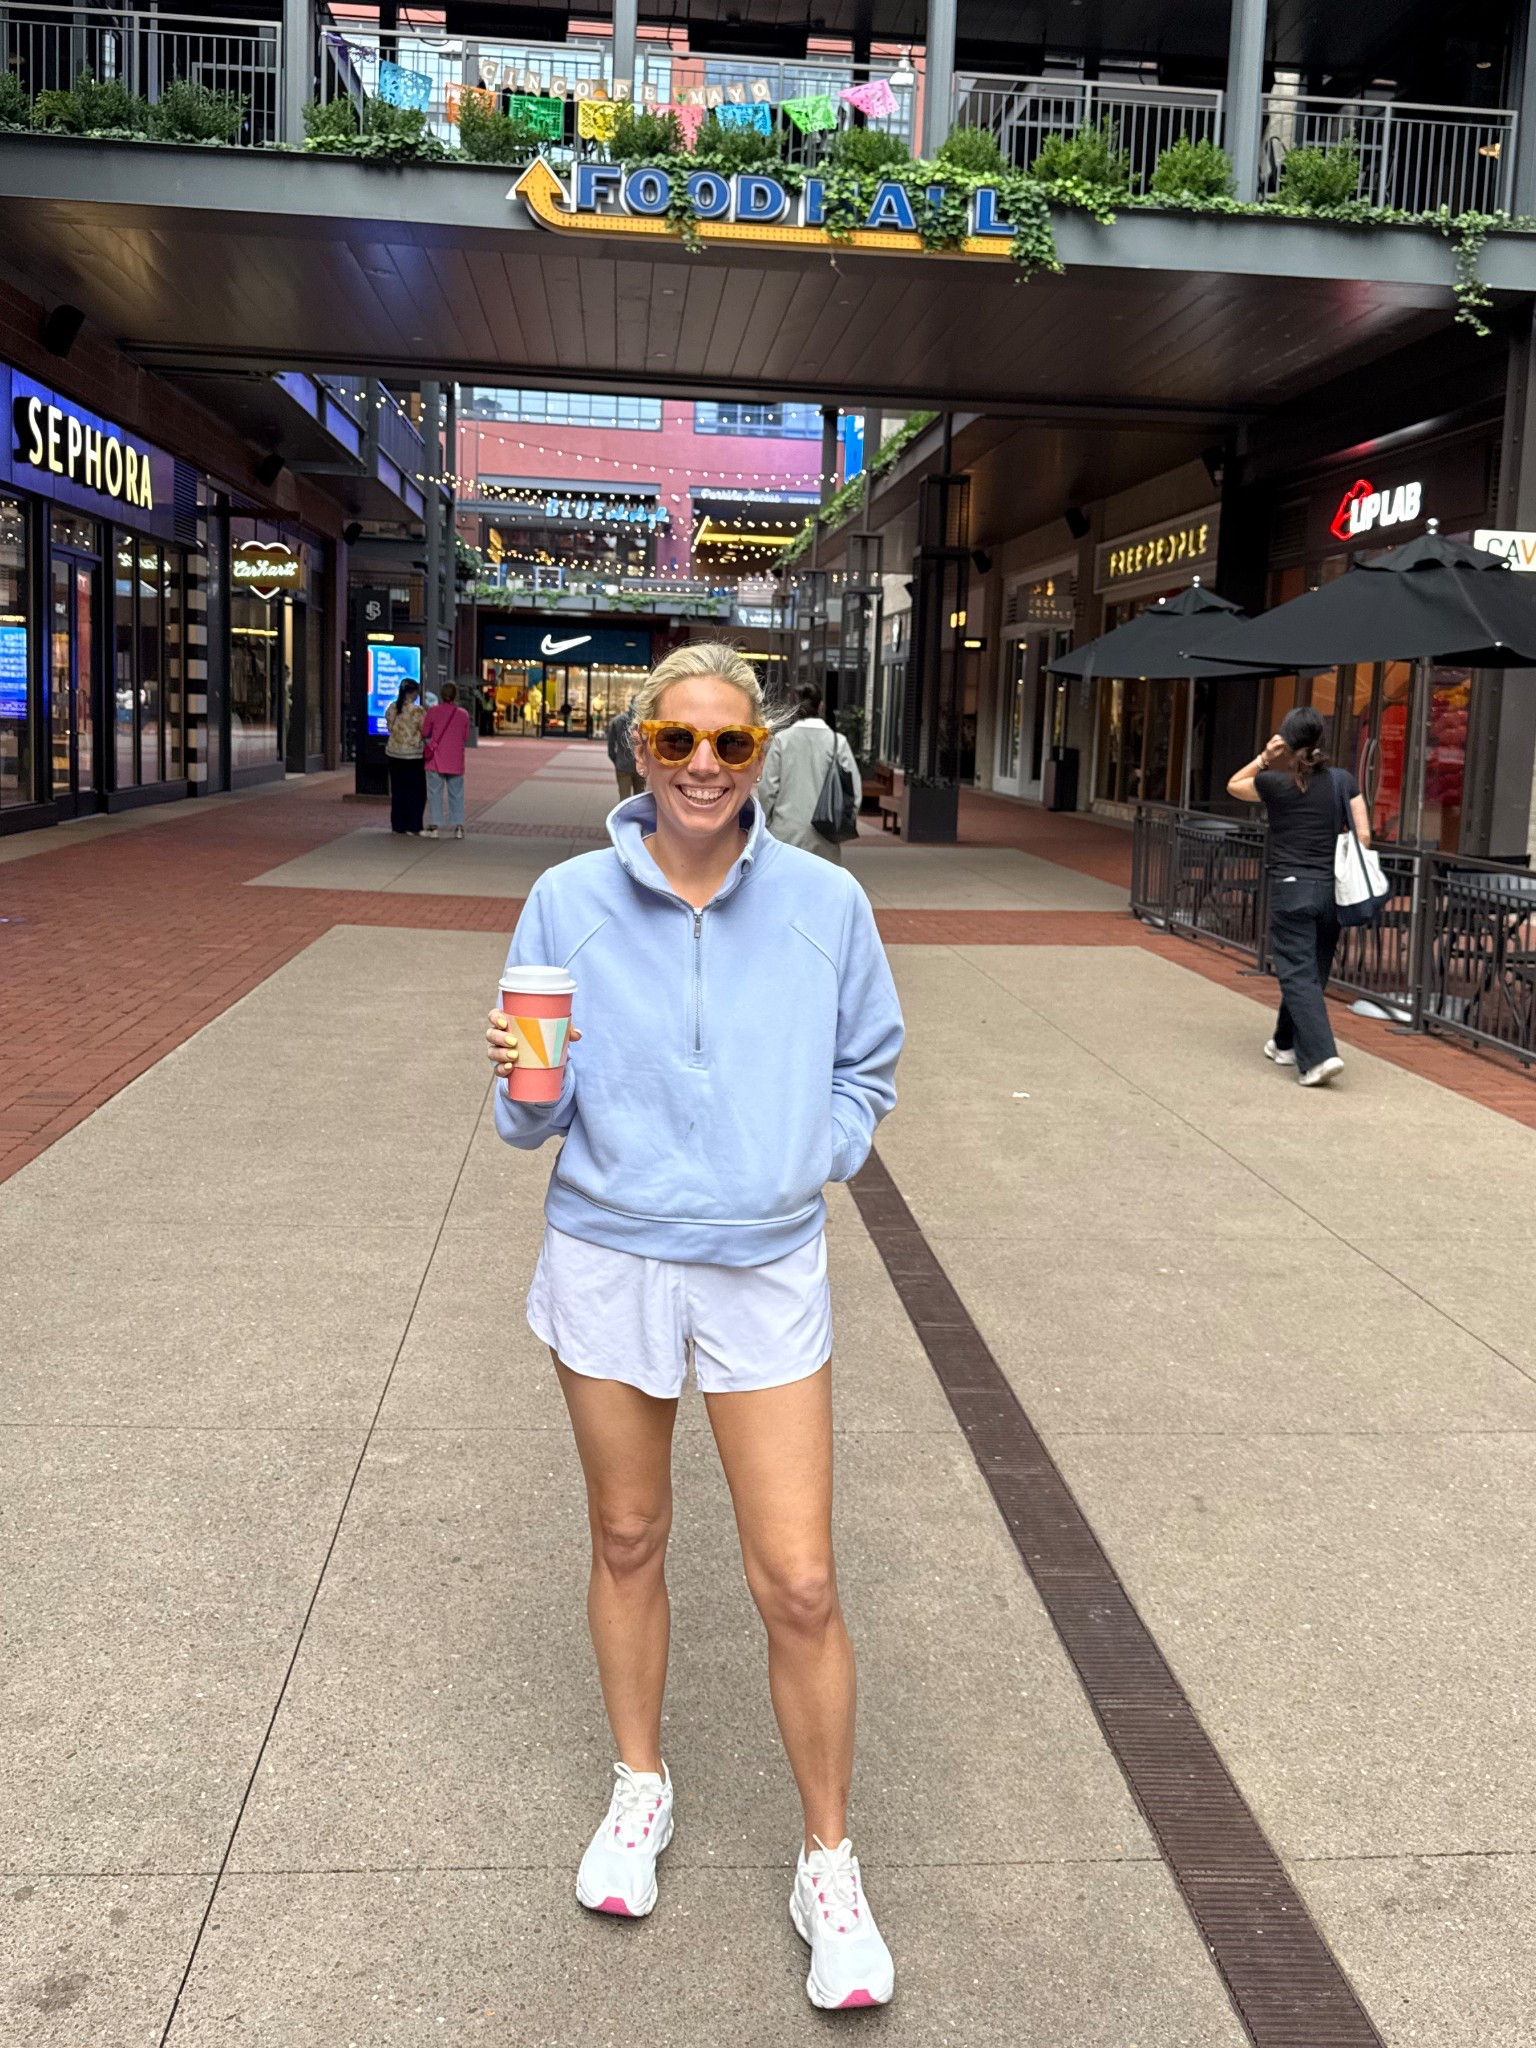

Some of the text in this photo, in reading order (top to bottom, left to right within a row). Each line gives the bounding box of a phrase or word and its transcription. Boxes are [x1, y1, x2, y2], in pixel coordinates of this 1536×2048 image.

[481, 63, 768, 105] CINCO DE MAYO
[573, 162, 1019, 236] FOOD HAL
[28, 396, 153, 511] SEPHORA
[1109, 523, 1209, 579] FREE PEOPLE
